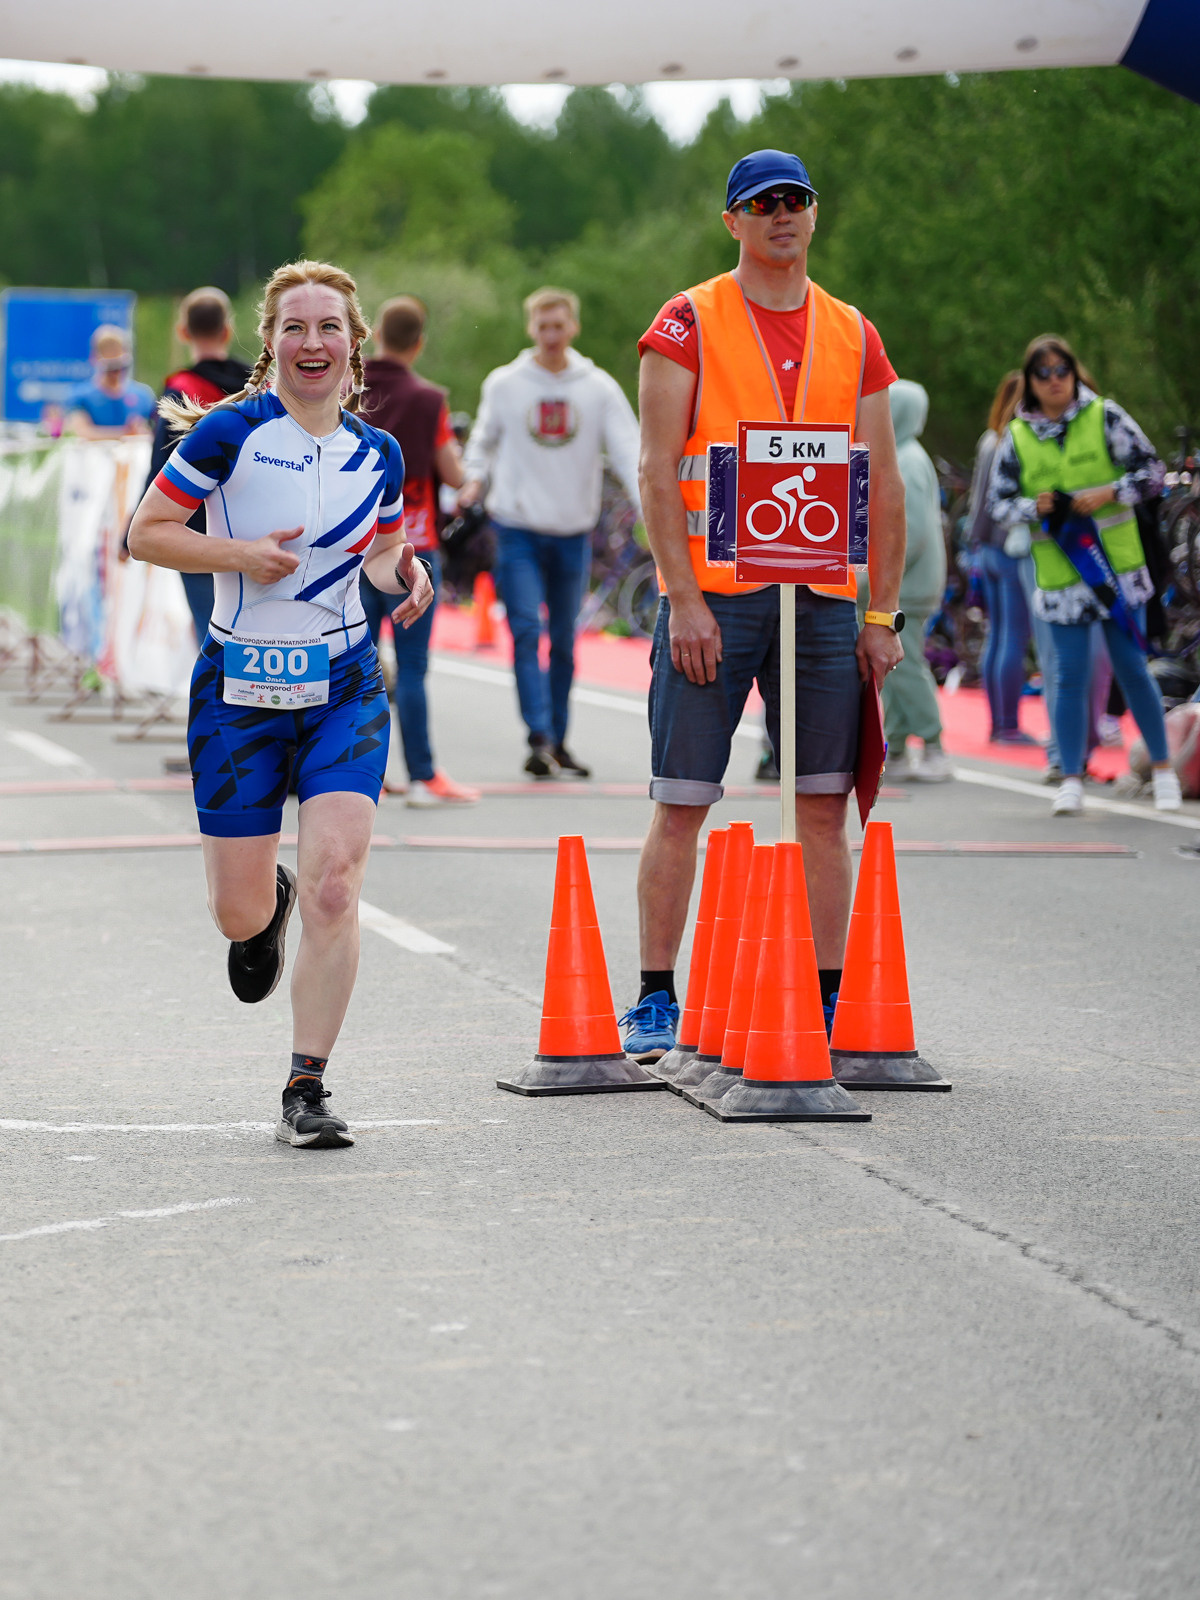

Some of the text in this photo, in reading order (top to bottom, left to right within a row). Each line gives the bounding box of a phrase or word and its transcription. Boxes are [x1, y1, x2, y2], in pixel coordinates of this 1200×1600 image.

[662, 318, 690, 342] TRI
[768, 436, 783, 458] 5
[253, 451, 304, 472] Severstal
[232, 635, 276, 645] НОВГОРОДСКИЙ
[242, 647, 309, 676] 200
[265, 675, 287, 683] Ольга
